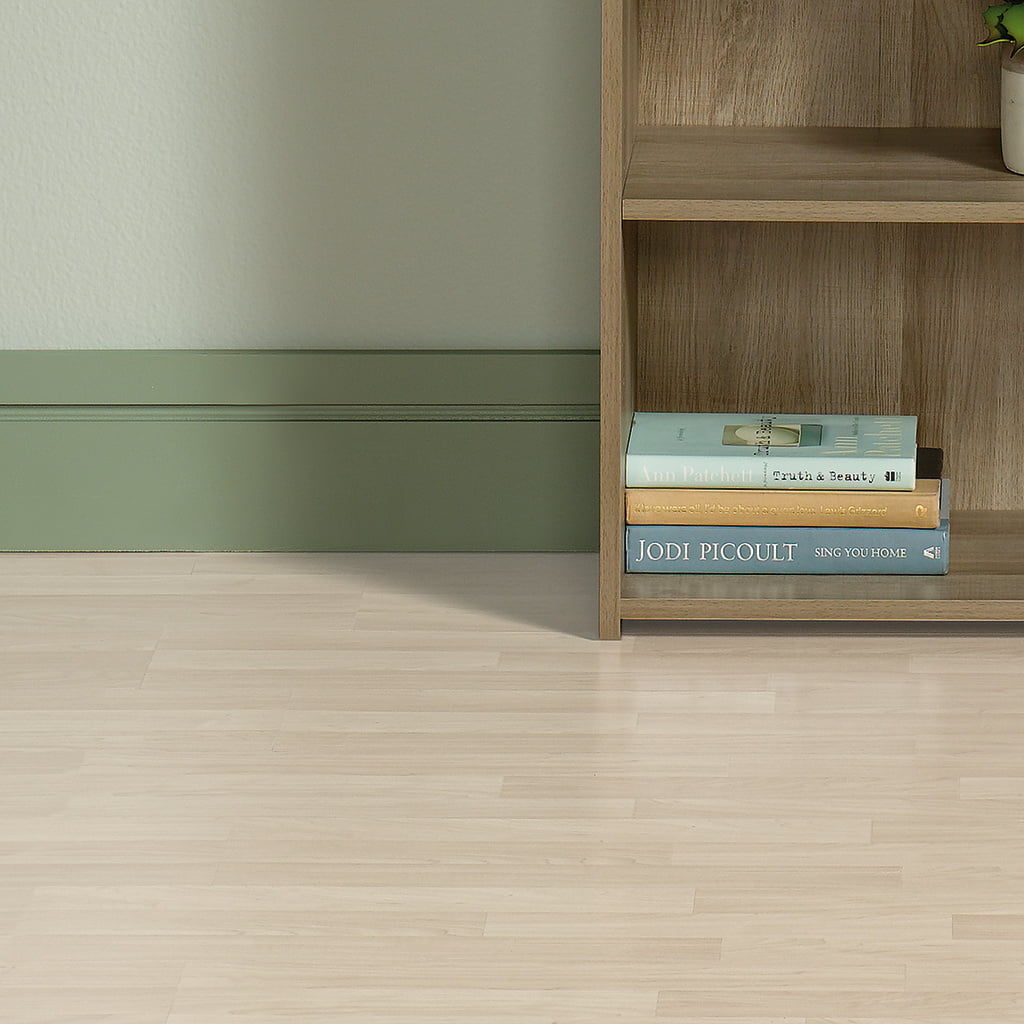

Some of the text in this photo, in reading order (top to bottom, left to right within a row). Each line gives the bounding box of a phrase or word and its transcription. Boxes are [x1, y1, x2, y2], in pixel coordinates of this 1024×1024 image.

[640, 464, 676, 483] Ann
[683, 465, 754, 483] Patchett
[772, 470, 813, 482] Truth
[816, 472, 825, 482] &
[829, 471, 876, 484] Beauty
[635, 539, 907, 562] JODI PICOULT SING YOU HOME
